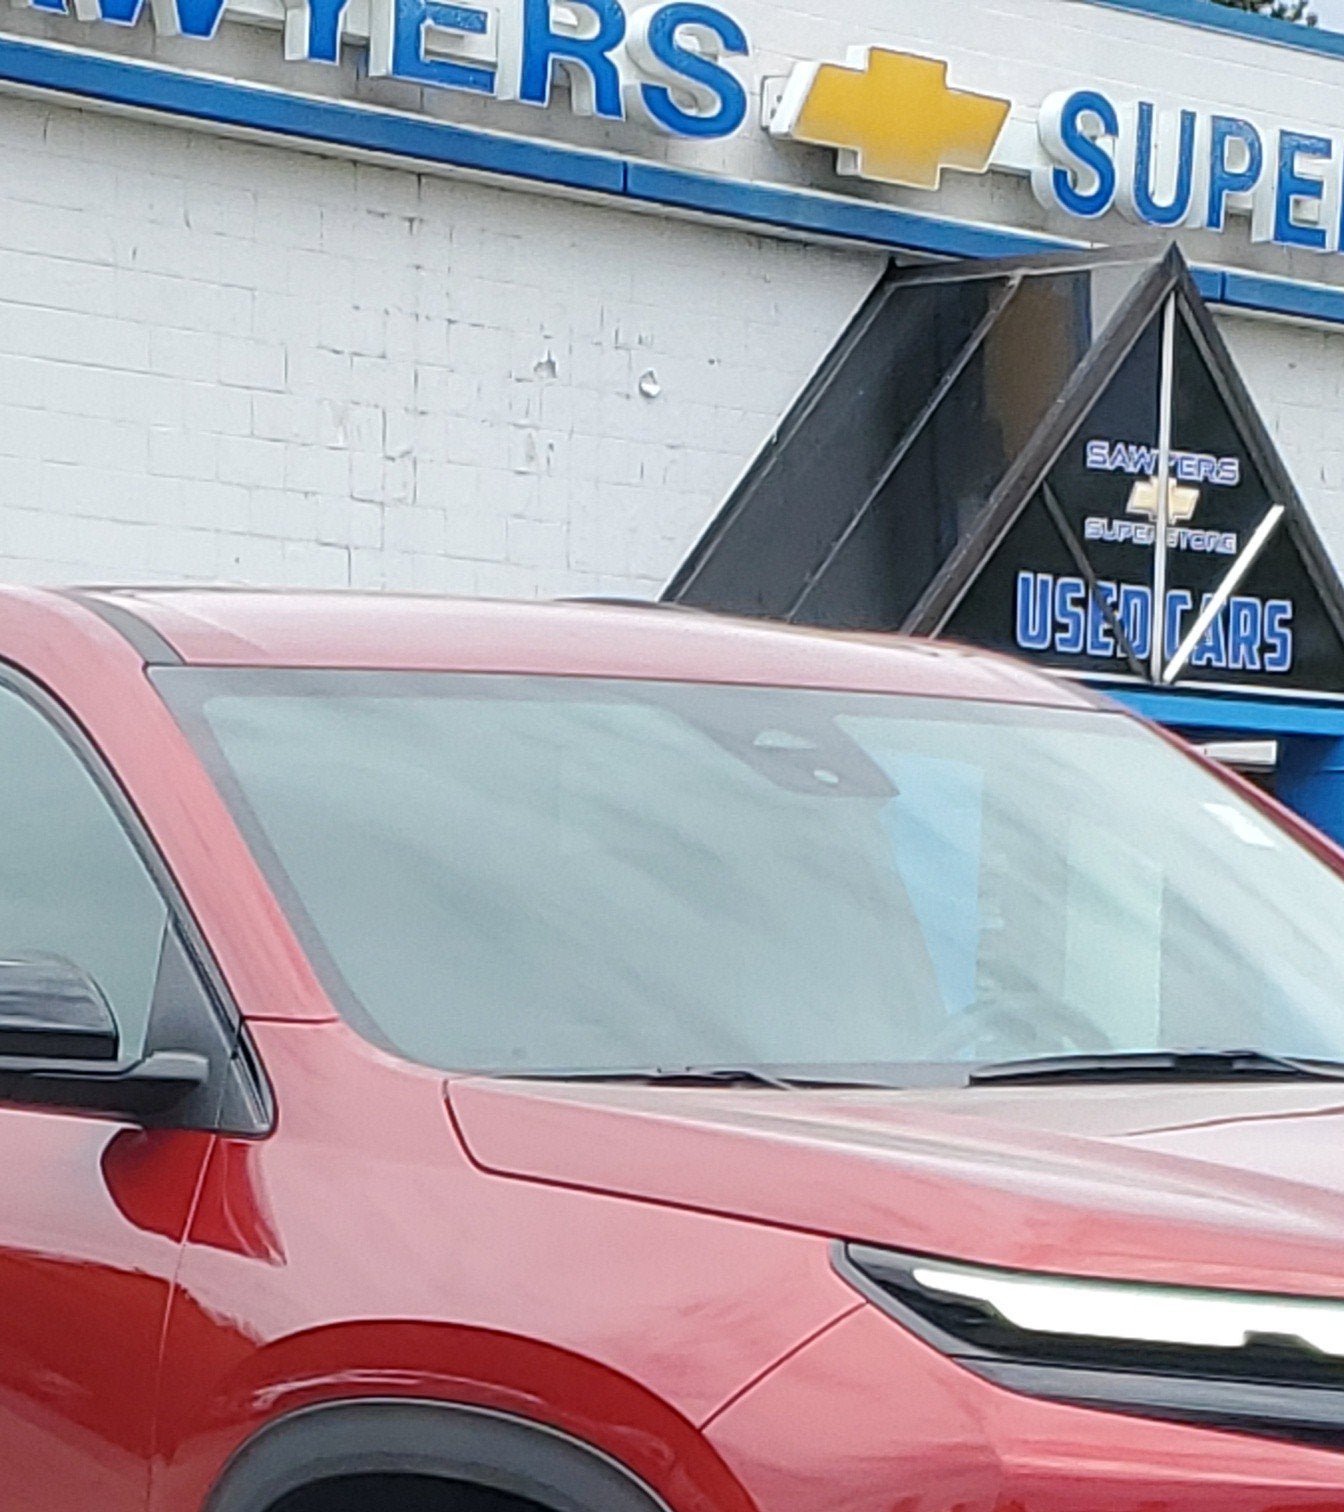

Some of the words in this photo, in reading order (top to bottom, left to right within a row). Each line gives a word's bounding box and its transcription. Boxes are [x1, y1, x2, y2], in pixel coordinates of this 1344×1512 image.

[22, 0, 750, 140] YERS
[1084, 516, 1237, 555] SUPESTORE
[1016, 570, 1152, 660] USED
[1164, 588, 1293, 672] CARS
